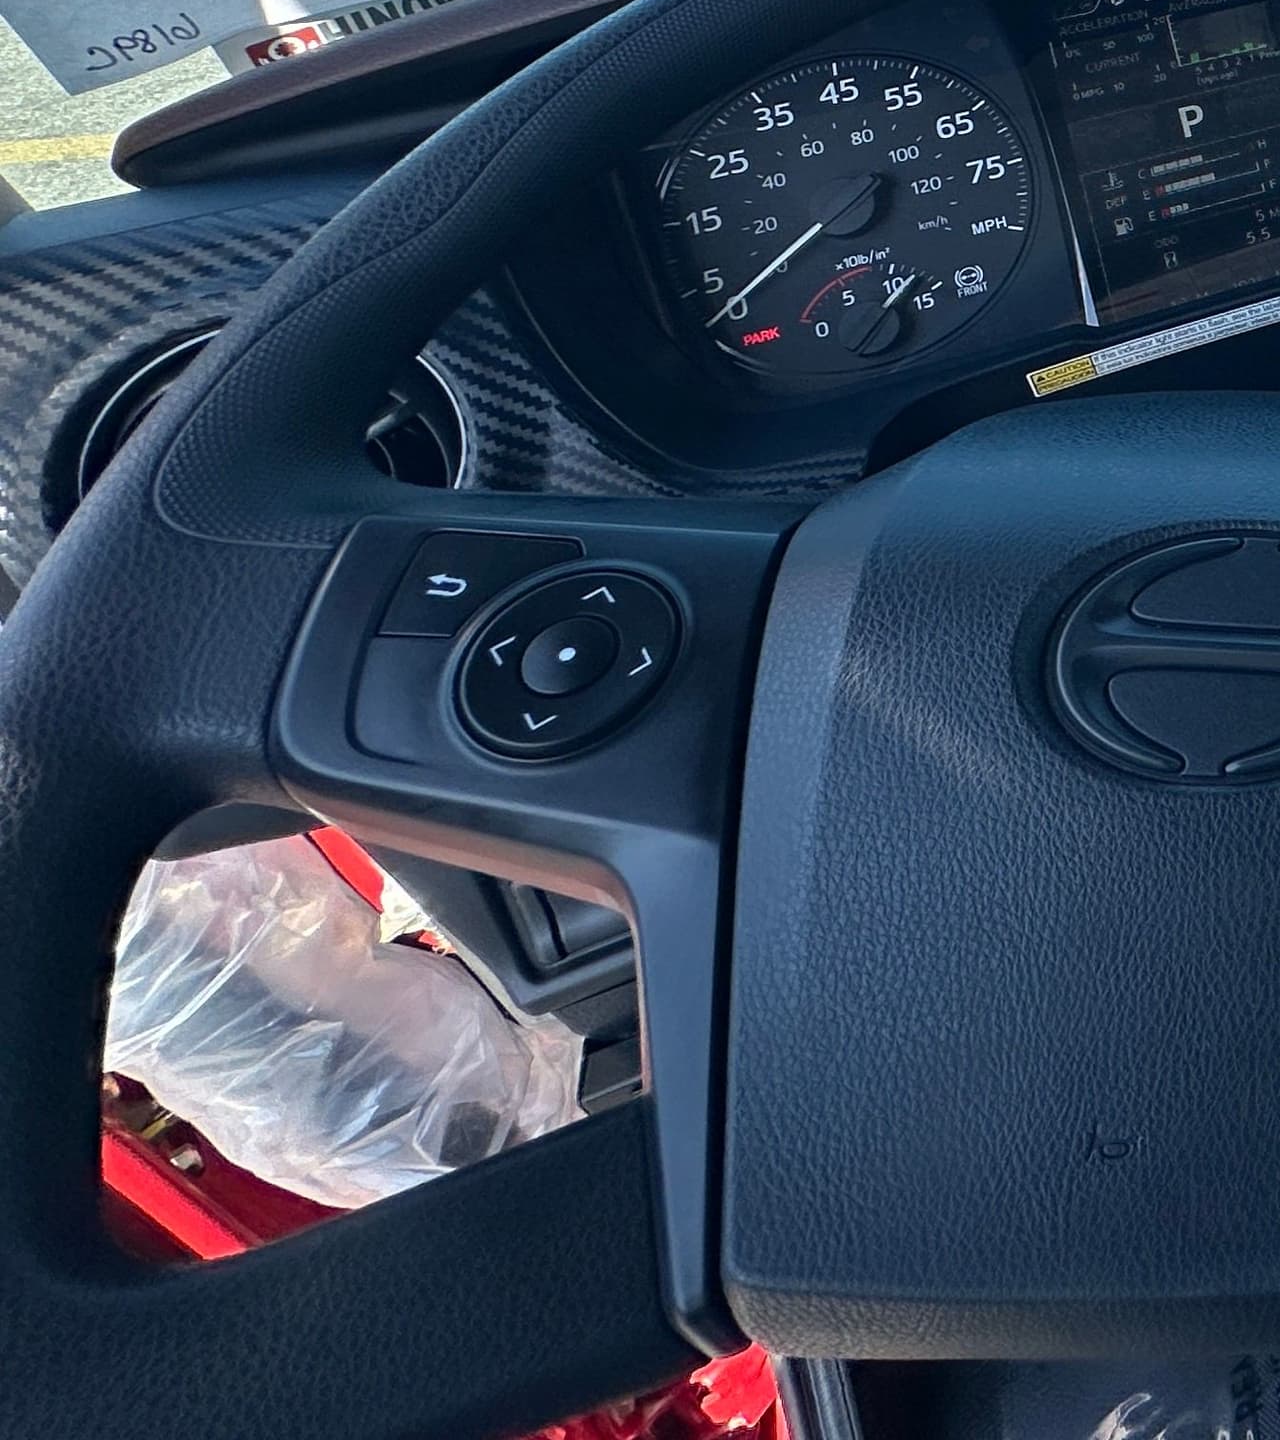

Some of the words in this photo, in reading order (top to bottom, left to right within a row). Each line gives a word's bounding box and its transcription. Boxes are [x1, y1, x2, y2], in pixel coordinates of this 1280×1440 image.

[1058, 10, 1149, 36] ACCELERATION
[1085, 52, 1142, 73] CURRENT
[819, 78, 859, 105] 45
[884, 82, 923, 111] 55
[753, 102, 795, 131] 35
[935, 112, 975, 139] 65
[1178, 105, 1204, 138] P
[850, 129, 874, 146] 80
[800, 139, 824, 157] 60
[888, 145, 919, 163] 100
[707, 150, 750, 179] 25
[966, 155, 1006, 183] 75
[762, 172, 786, 189] 40
[911, 176, 942, 195] 120
[684, 208, 722, 235] 15
[753, 216, 778, 234] 20
[918, 216, 949, 231] km/h
[971, 216, 1008, 235] MPH
[1148, 210, 1156, 222] E
[703, 269, 724, 293] 5
[882, 276, 905, 295] 10
[956, 280, 988, 298] FRONT
[842, 290, 856, 306] 5
[913, 292, 935, 310] 15
[727, 295, 748, 321] 0
[743, 327, 781, 346] PARK
[815, 322, 829, 338] 0
[1117, 337, 1155, 354] indicator
[1155, 330, 1177, 345] light
[1247, 306, 1261, 315] the
[1261, 300, 1280, 311] label
[1044, 358, 1090, 378] CAUTION
